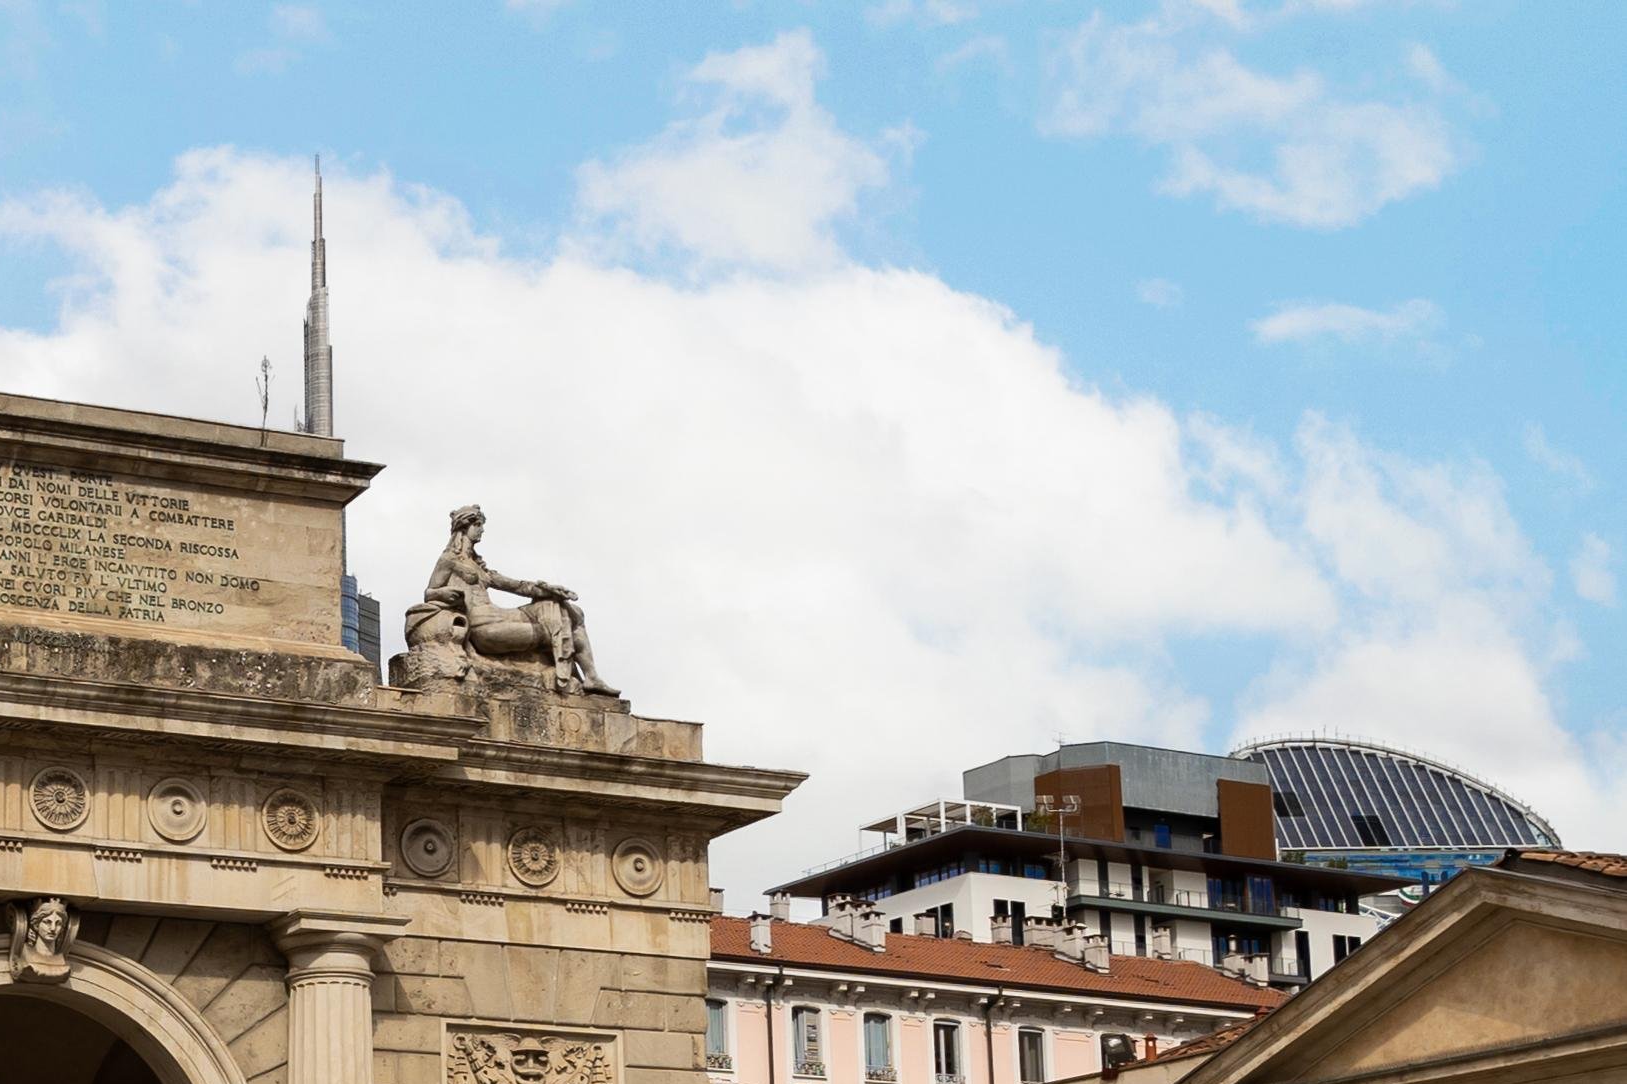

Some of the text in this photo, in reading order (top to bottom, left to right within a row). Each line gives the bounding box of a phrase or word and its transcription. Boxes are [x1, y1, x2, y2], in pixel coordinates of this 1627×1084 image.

[71, 471, 113, 487] PORTE
[9, 478, 30, 490] DAI
[37, 482, 71, 495] NOMI
[79, 487, 119, 502] DELLE
[126, 493, 190, 511] VITTORIE
[38, 511, 107, 529] GARIBALDI
[41, 496, 122, 517] VOLONTARII
[131, 508, 139, 519] A
[149, 511, 235, 531] COMBATTERE
[11, 521, 80, 540] MDCCCLIX
[89, 531, 105, 543] LA
[113, 534, 172, 552] SECONDA
[180, 542, 239, 559] RISCOSSA
[60, 542, 125, 559] MILANESE
[0, 550, 31, 563] ANNI
[53, 556, 87, 569] EROE
[95, 560, 177, 580] INCANVTITO
[186, 572, 214, 584] NON
[221, 576, 260, 592] DOMO
[11, 565, 66, 581] SALVTO
[74, 572, 92, 585] FV
[118, 577, 167, 593] VLTIMO
[23, 581, 66, 597] CVORI
[106, 591, 132, 603] CHE
[140, 595, 165, 608] NEL
[172, 599, 224, 614] BRONZO
[69, 601, 111, 616] DELLA
[119, 607, 165, 622] PATRIA
